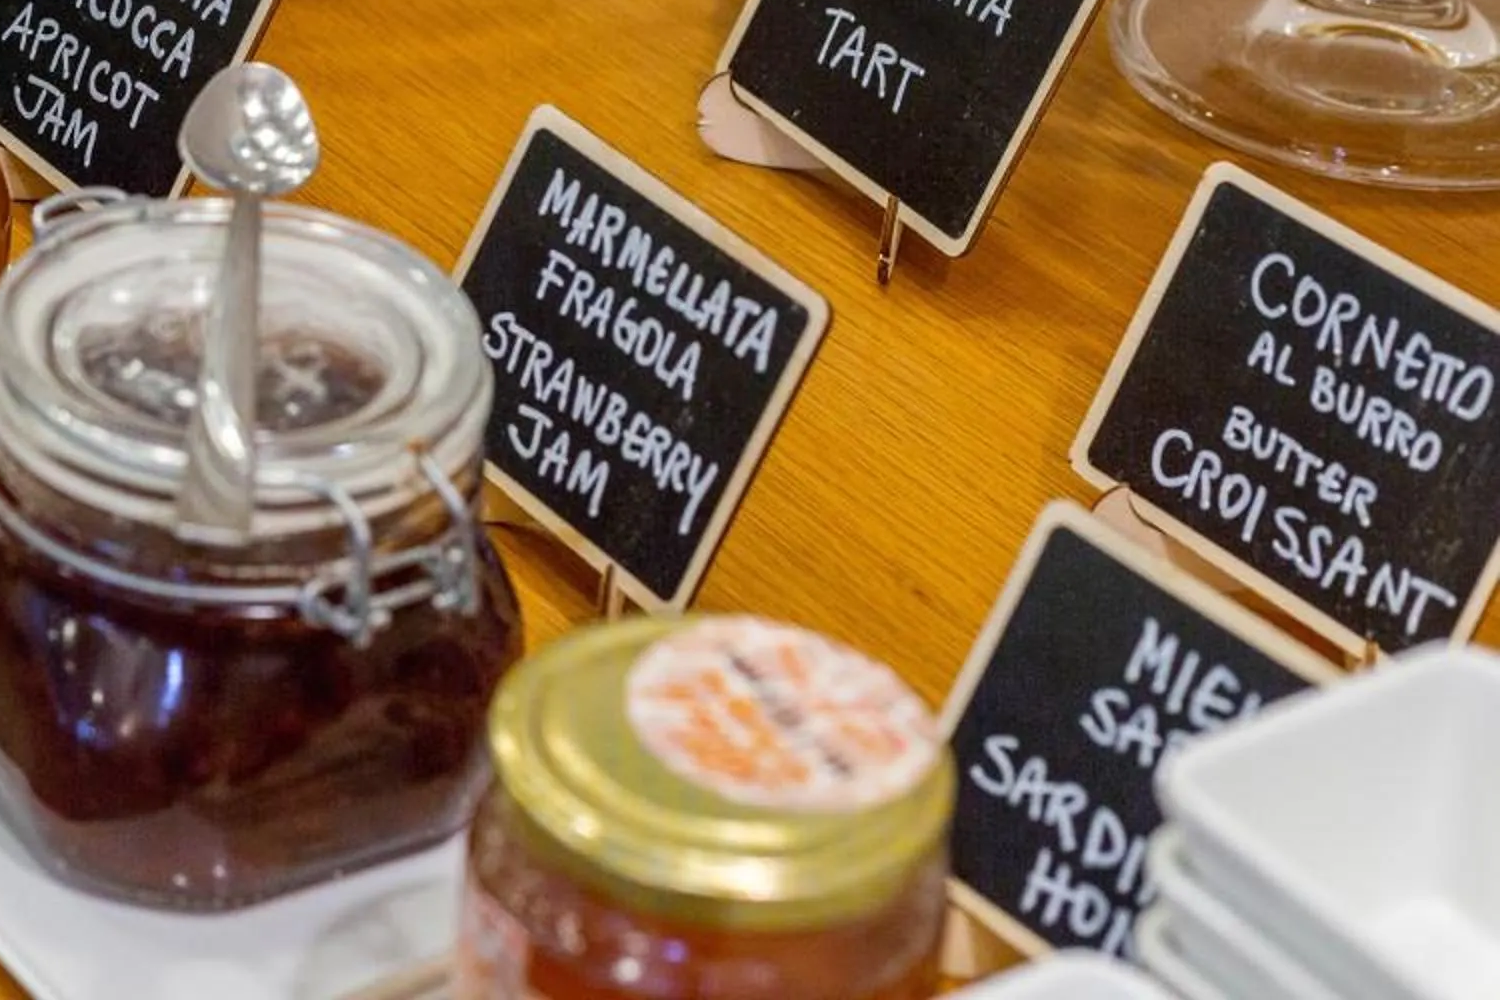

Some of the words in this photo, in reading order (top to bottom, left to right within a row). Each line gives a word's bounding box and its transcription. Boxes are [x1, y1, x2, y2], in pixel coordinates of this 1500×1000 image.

[1, 3, 160, 130] APRICOT
[14, 75, 99, 167] JAM
[817, 8, 925, 114] TART
[536, 249, 701, 400] FRAGOLA
[538, 168, 778, 374] MARMELLATA
[1250, 253, 1494, 421] CORNETTO
[482, 312, 719, 535] STRAWBERRY
[507, 404, 609, 518] JAM
[1222, 405, 1379, 527] BUTTER
[1247, 331, 1296, 386] AL
[1310, 366, 1443, 472] BURRO
[1151, 429, 1456, 635] CROISSANT
